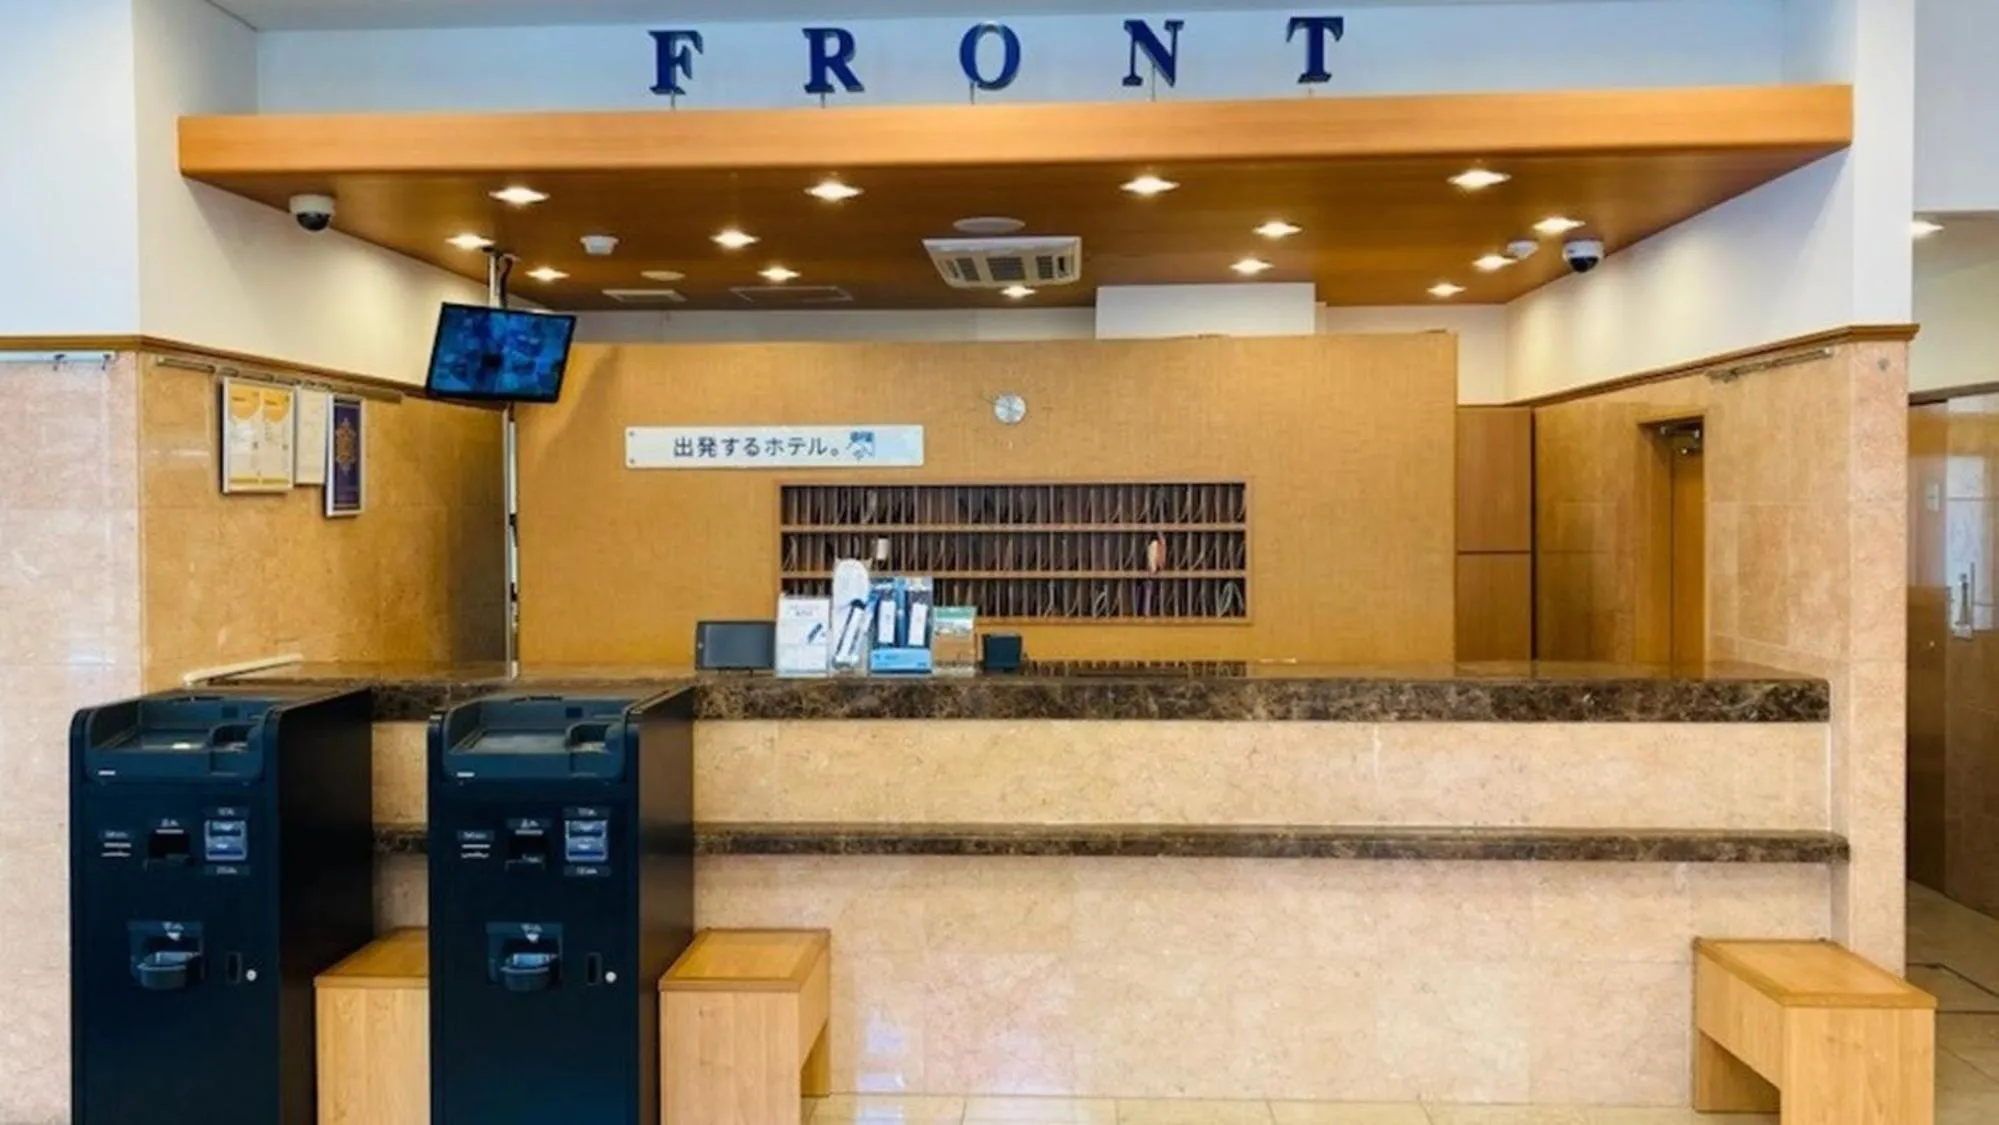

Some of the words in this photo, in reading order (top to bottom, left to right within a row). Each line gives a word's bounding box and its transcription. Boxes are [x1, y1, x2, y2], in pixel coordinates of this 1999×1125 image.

[649, 16, 1345, 95] FRONT
[673, 435, 840, 458] 出発するホテル。
